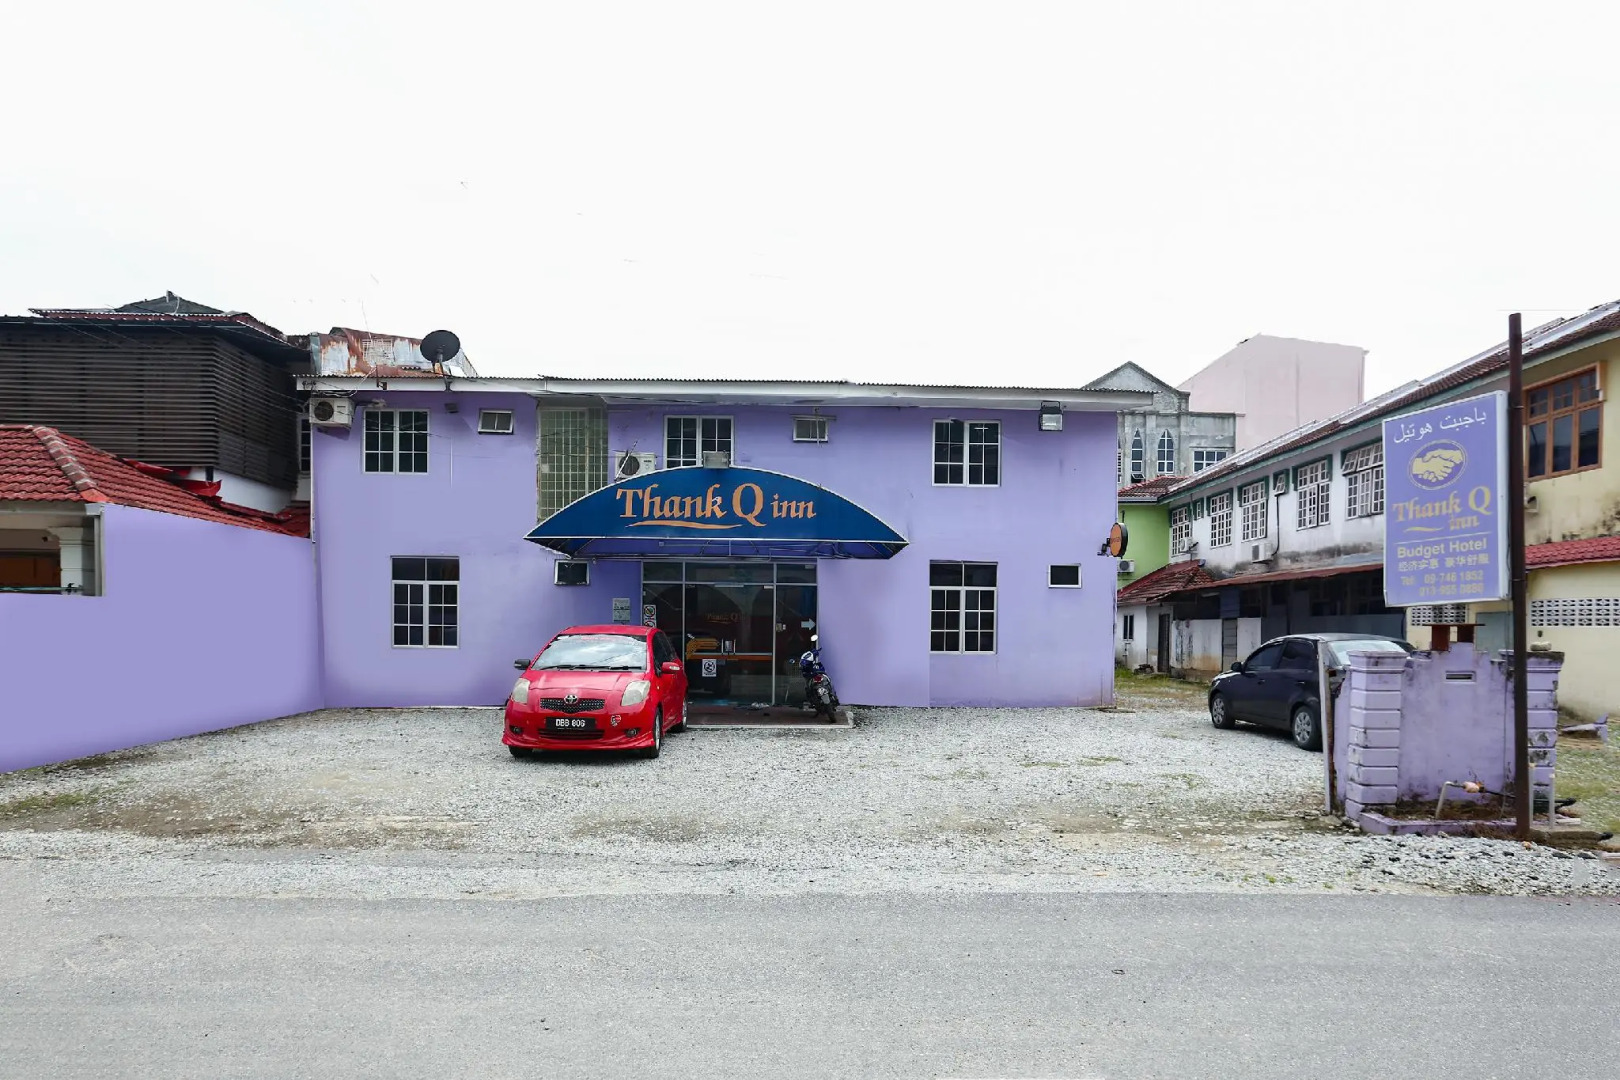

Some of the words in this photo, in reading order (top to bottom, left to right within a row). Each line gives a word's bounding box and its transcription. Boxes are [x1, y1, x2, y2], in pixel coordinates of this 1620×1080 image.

[615, 483, 727, 518] Thank
[732, 482, 767, 527] Q
[770, 493, 816, 518] inn
[1392, 491, 1463, 522] Thank
[1468, 486, 1492, 515] Q
[1449, 514, 1479, 531] inn
[1397, 543, 1445, 559] Budget
[1449, 538, 1487, 553] Hotel
